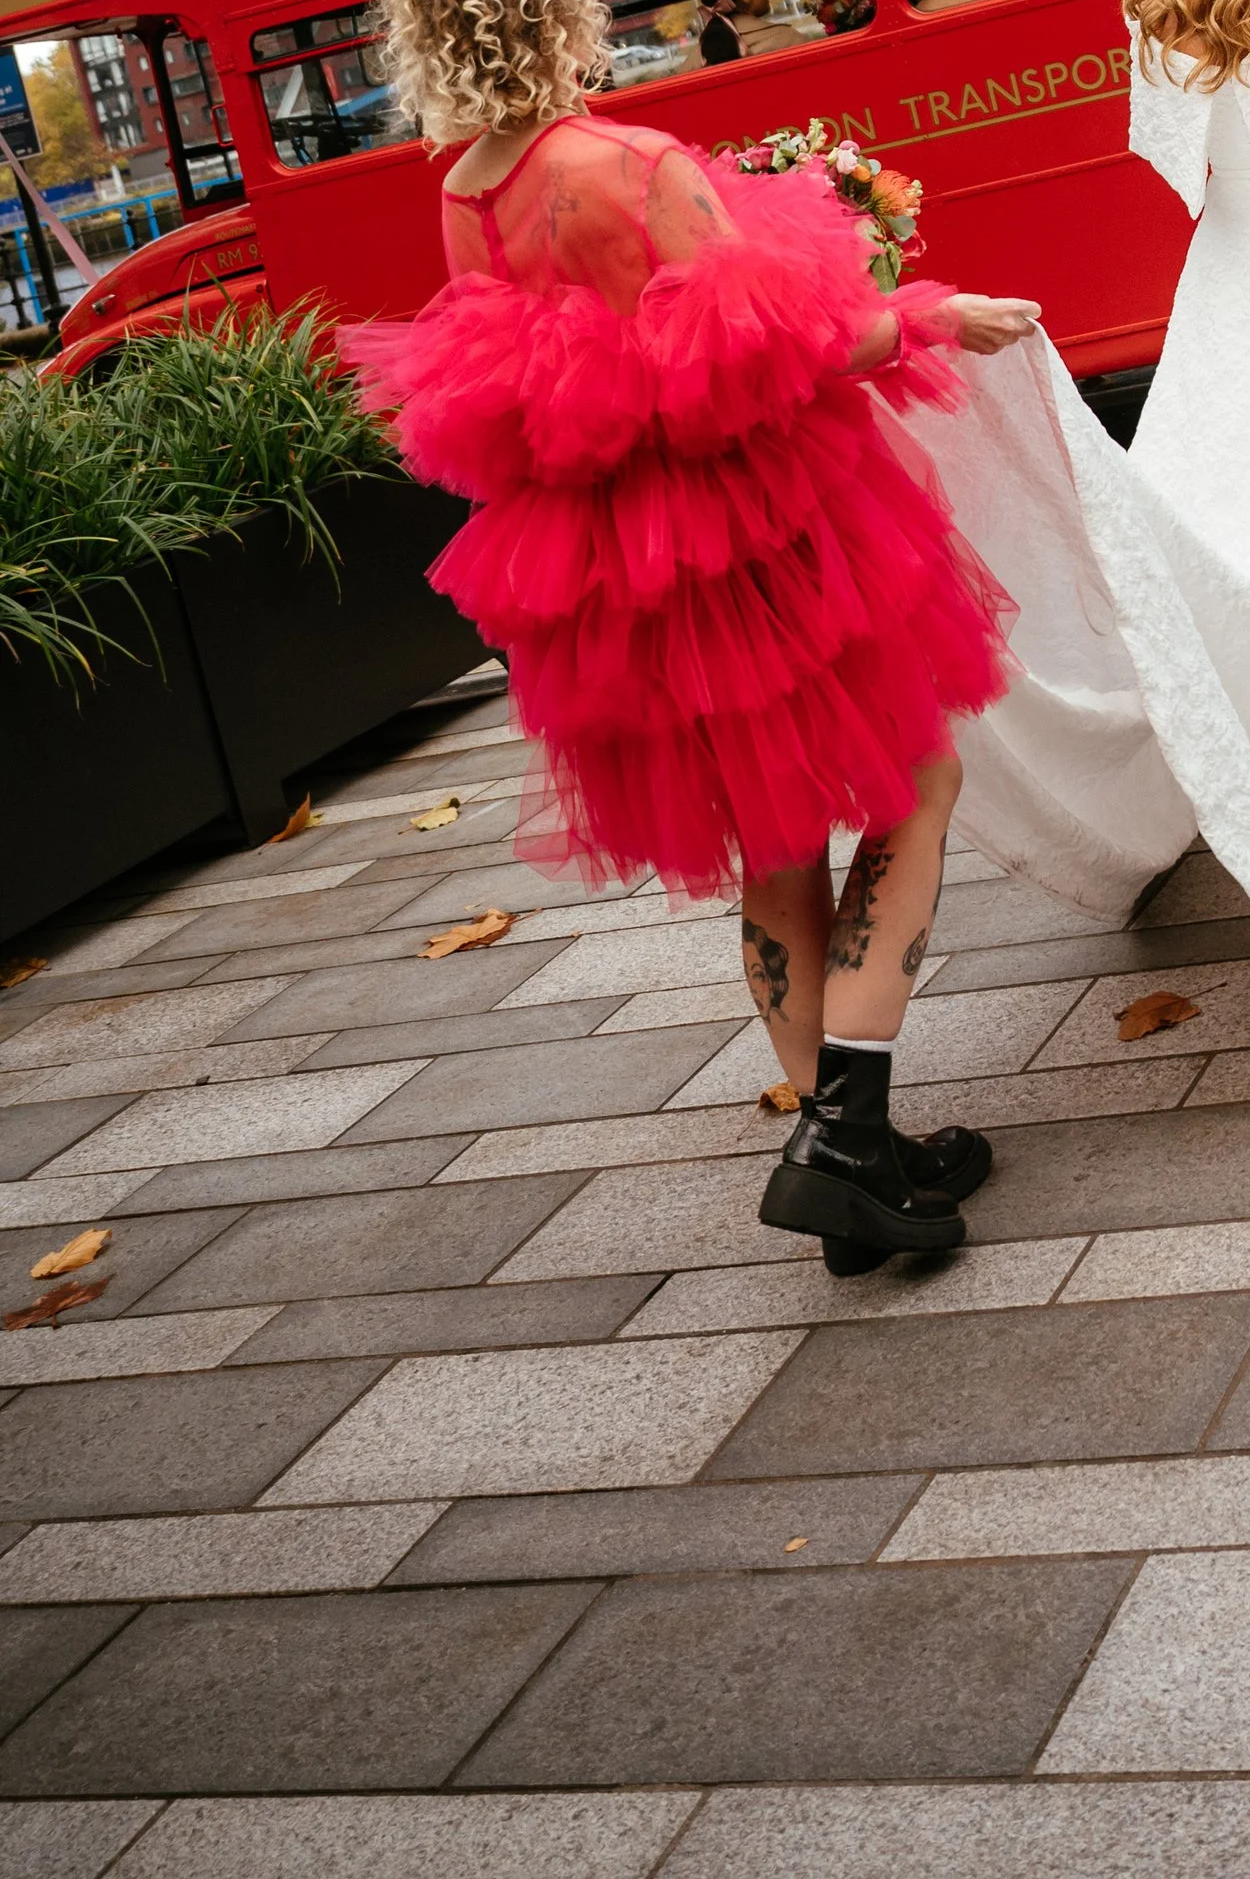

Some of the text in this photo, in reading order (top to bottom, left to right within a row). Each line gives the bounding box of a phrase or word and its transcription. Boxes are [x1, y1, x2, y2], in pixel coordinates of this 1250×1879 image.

[900, 47, 1131, 130] TRANSPOR
[216, 241, 263, 270] RM 9
